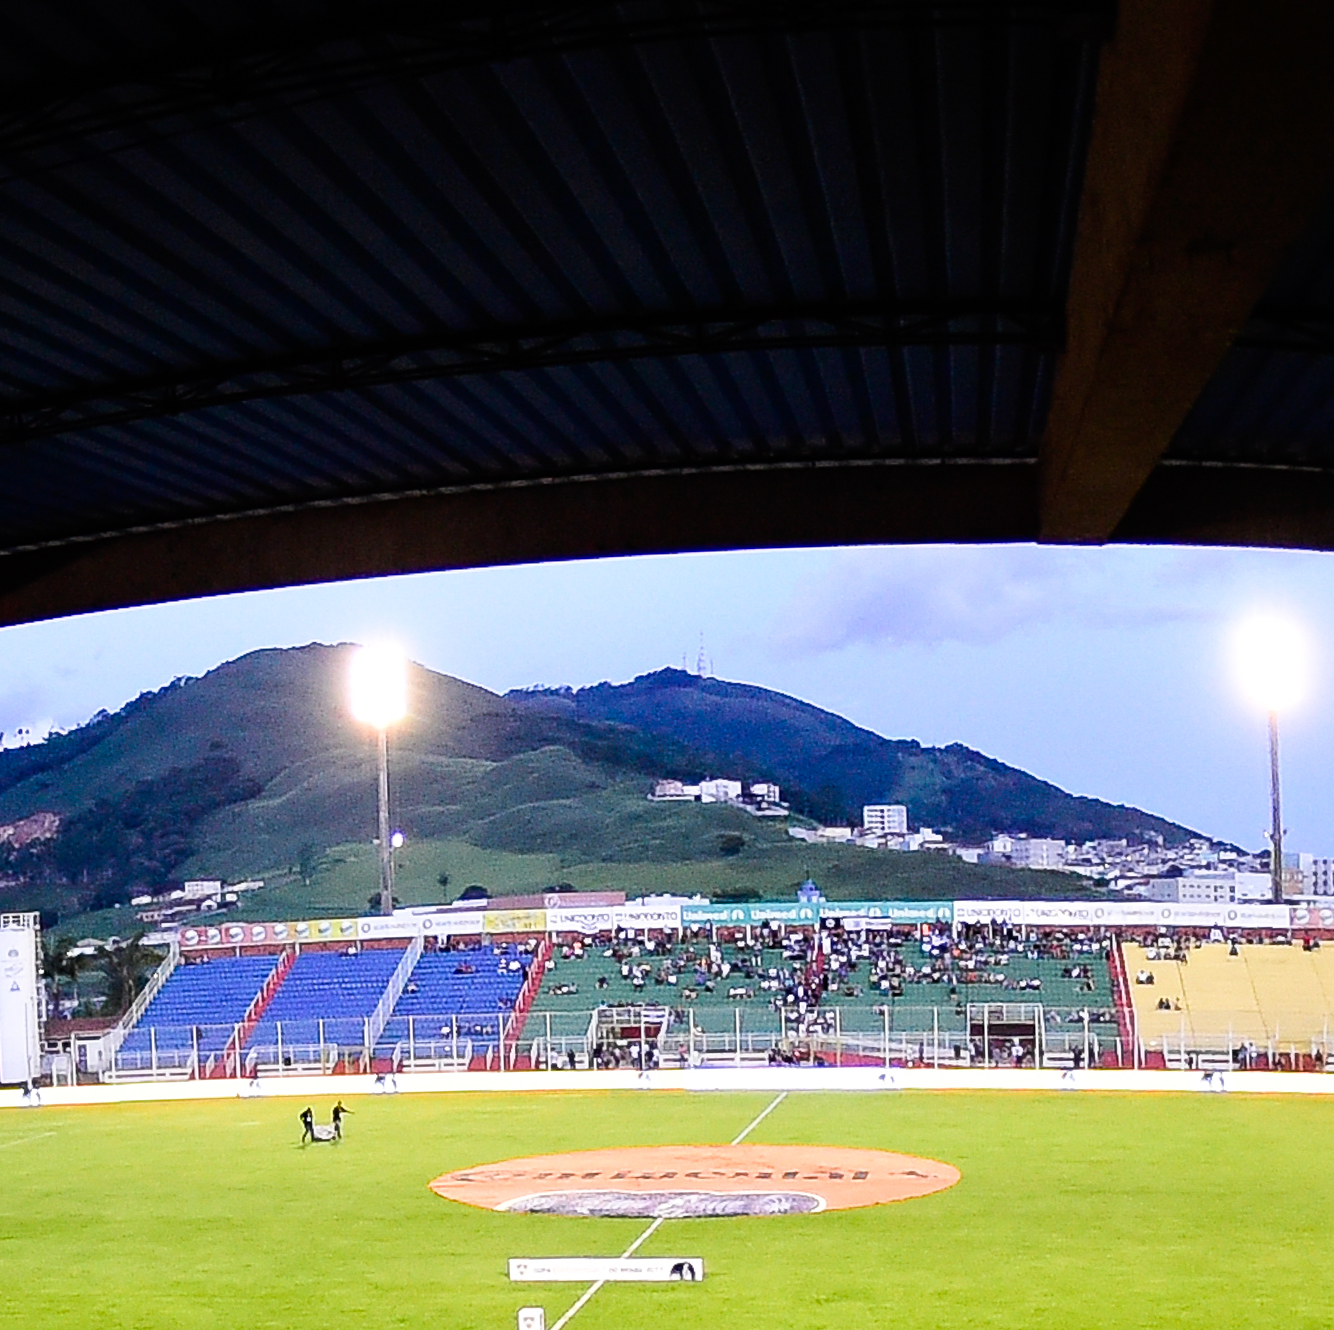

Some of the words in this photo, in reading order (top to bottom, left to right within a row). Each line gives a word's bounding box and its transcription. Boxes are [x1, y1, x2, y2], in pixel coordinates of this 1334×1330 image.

[683, 909, 728, 921] Unimed
[750, 908, 796, 921] Unimed
[819, 907, 865, 919] Unimed
[888, 907, 934, 920] Unimed
